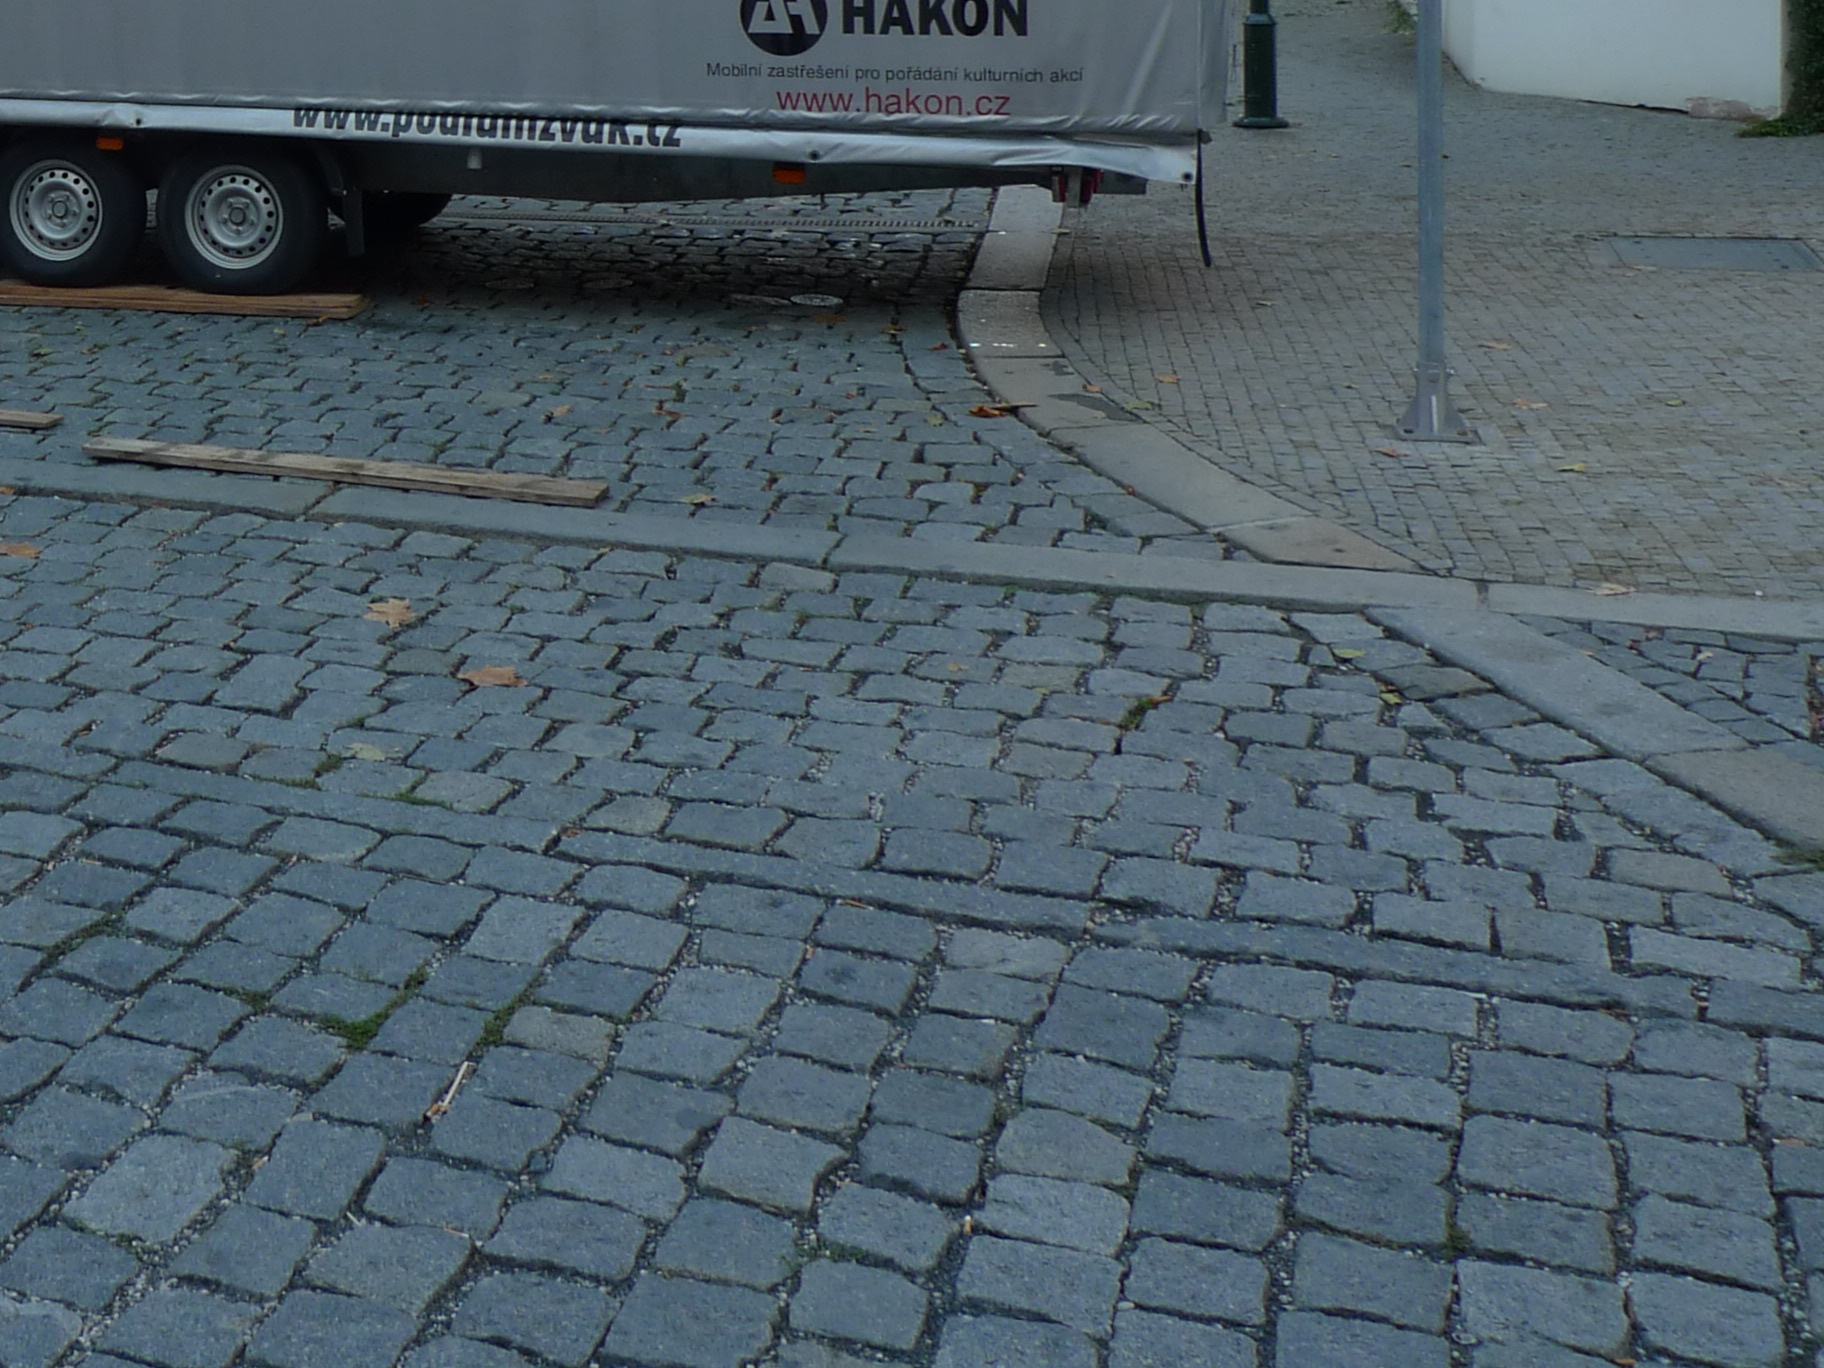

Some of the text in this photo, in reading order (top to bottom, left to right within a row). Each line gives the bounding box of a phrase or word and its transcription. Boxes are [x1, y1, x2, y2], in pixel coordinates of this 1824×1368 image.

[706, 62, 763, 78] Mobilní
[767, 63, 850, 79] zastřešení
[855, 67, 881, 82] pro
[963, 67, 1044, 82] kulturních
[1049, 67, 1084, 83] akcí
[776, 86, 1012, 116] www.hakon.cz
